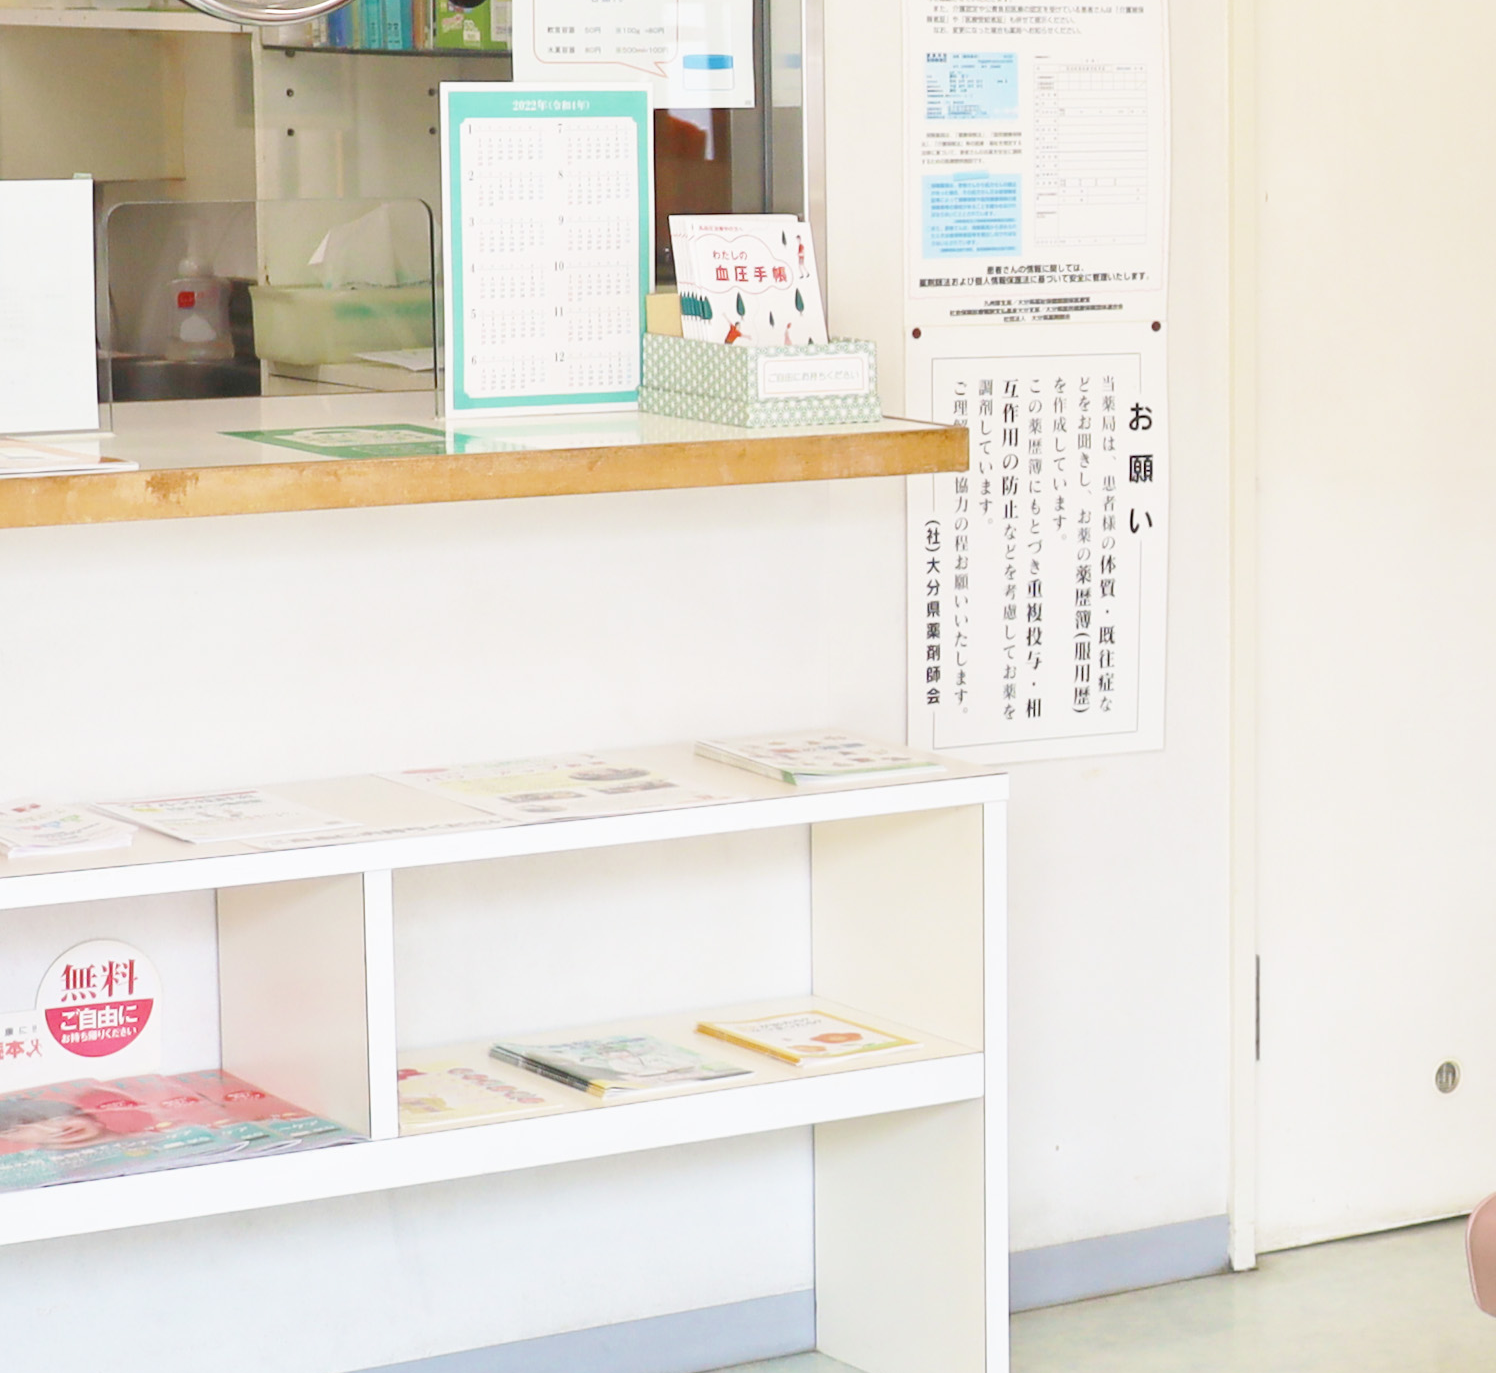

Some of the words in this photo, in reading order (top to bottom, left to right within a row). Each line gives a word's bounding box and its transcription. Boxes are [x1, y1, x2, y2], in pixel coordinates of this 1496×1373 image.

[712, 249, 748, 262] わたしの
[715, 265, 788, 283] 血圧手帳
[979, 378, 994, 526] 調剤しています。
[1053, 378, 1069, 542] を作成しています。
[1129, 402, 1154, 535] お願い
[924, 519, 941, 706] (社)大分県薬剤師会
[953, 380, 970, 716] ご理協力の程お願いいたします。
[1001, 378, 1020, 721] 互作用の防止などを考慮してお薬を
[1025, 378, 1044, 719] この薬歴簿にもとづき重複投与・相
[1098, 374, 1117, 713] 当薬局は、患者様の体質・既往症な
[60, 957, 139, 1003] 無料
[60, 1004, 139, 1032] ご自由に
[60, 1026, 137, 1045] お持ち帰りください
